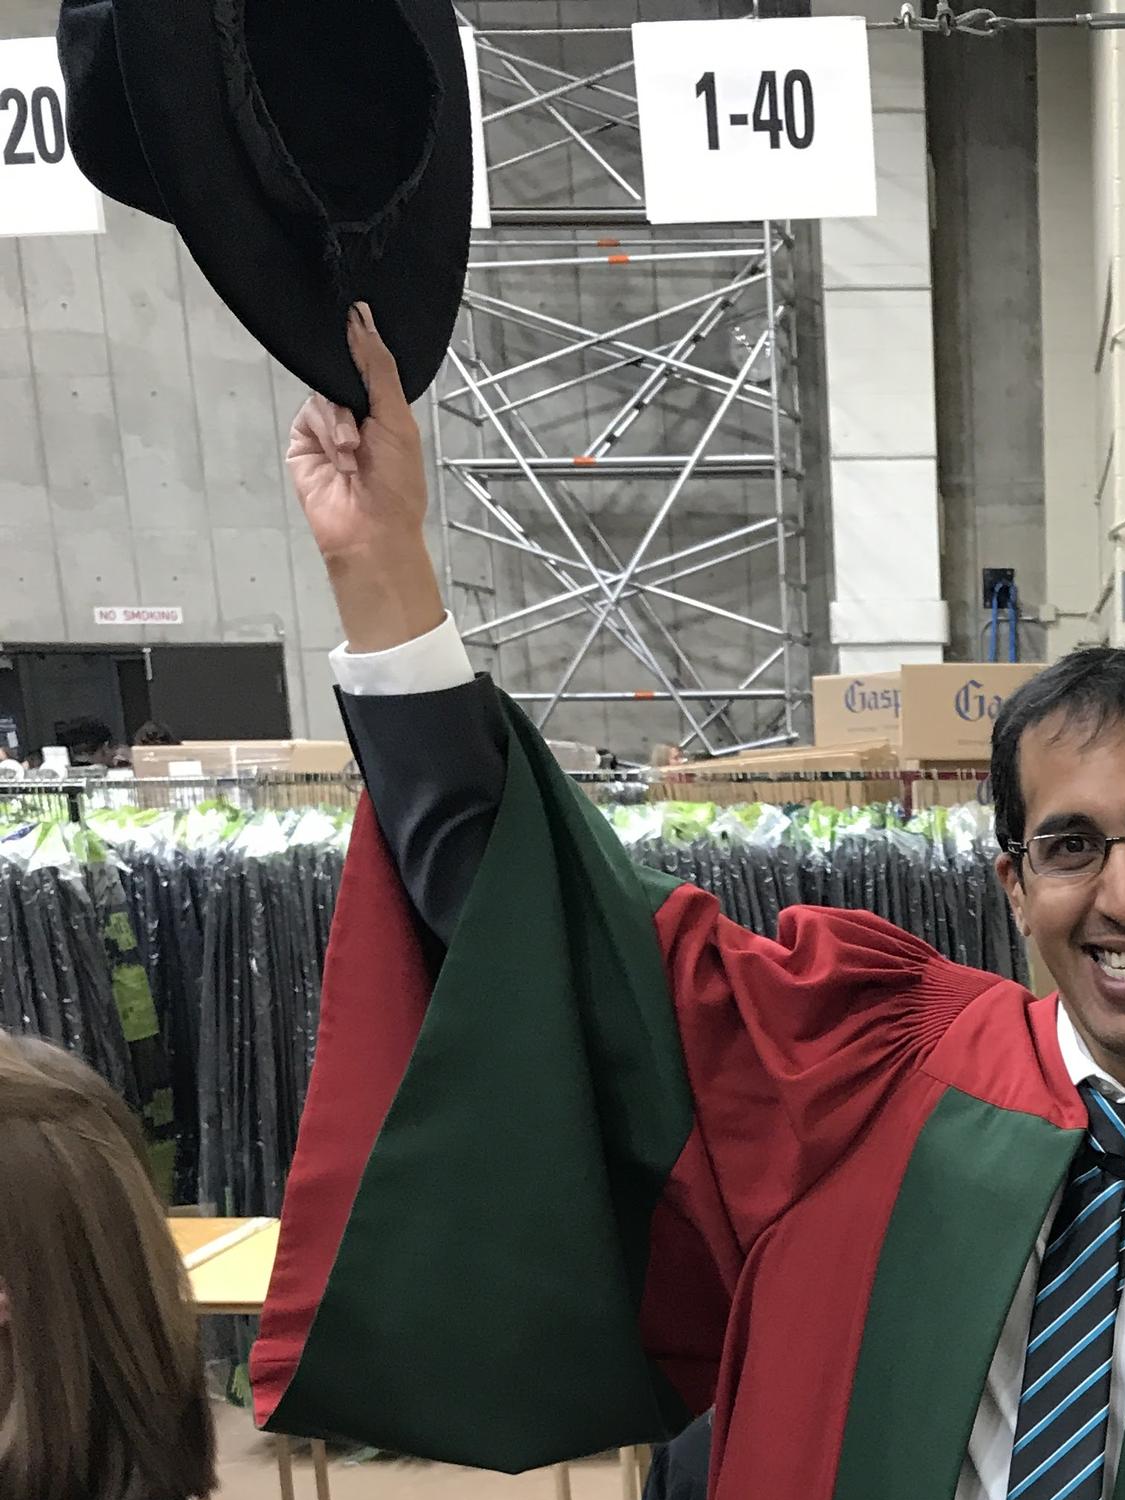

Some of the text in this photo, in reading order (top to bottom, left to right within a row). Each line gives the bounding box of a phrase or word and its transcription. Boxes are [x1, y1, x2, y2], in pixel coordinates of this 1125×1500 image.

[0, 86, 65, 165] 20
[695, 69, 815, 150] 1-40
[99, 609, 178, 621] NO SMOKING
